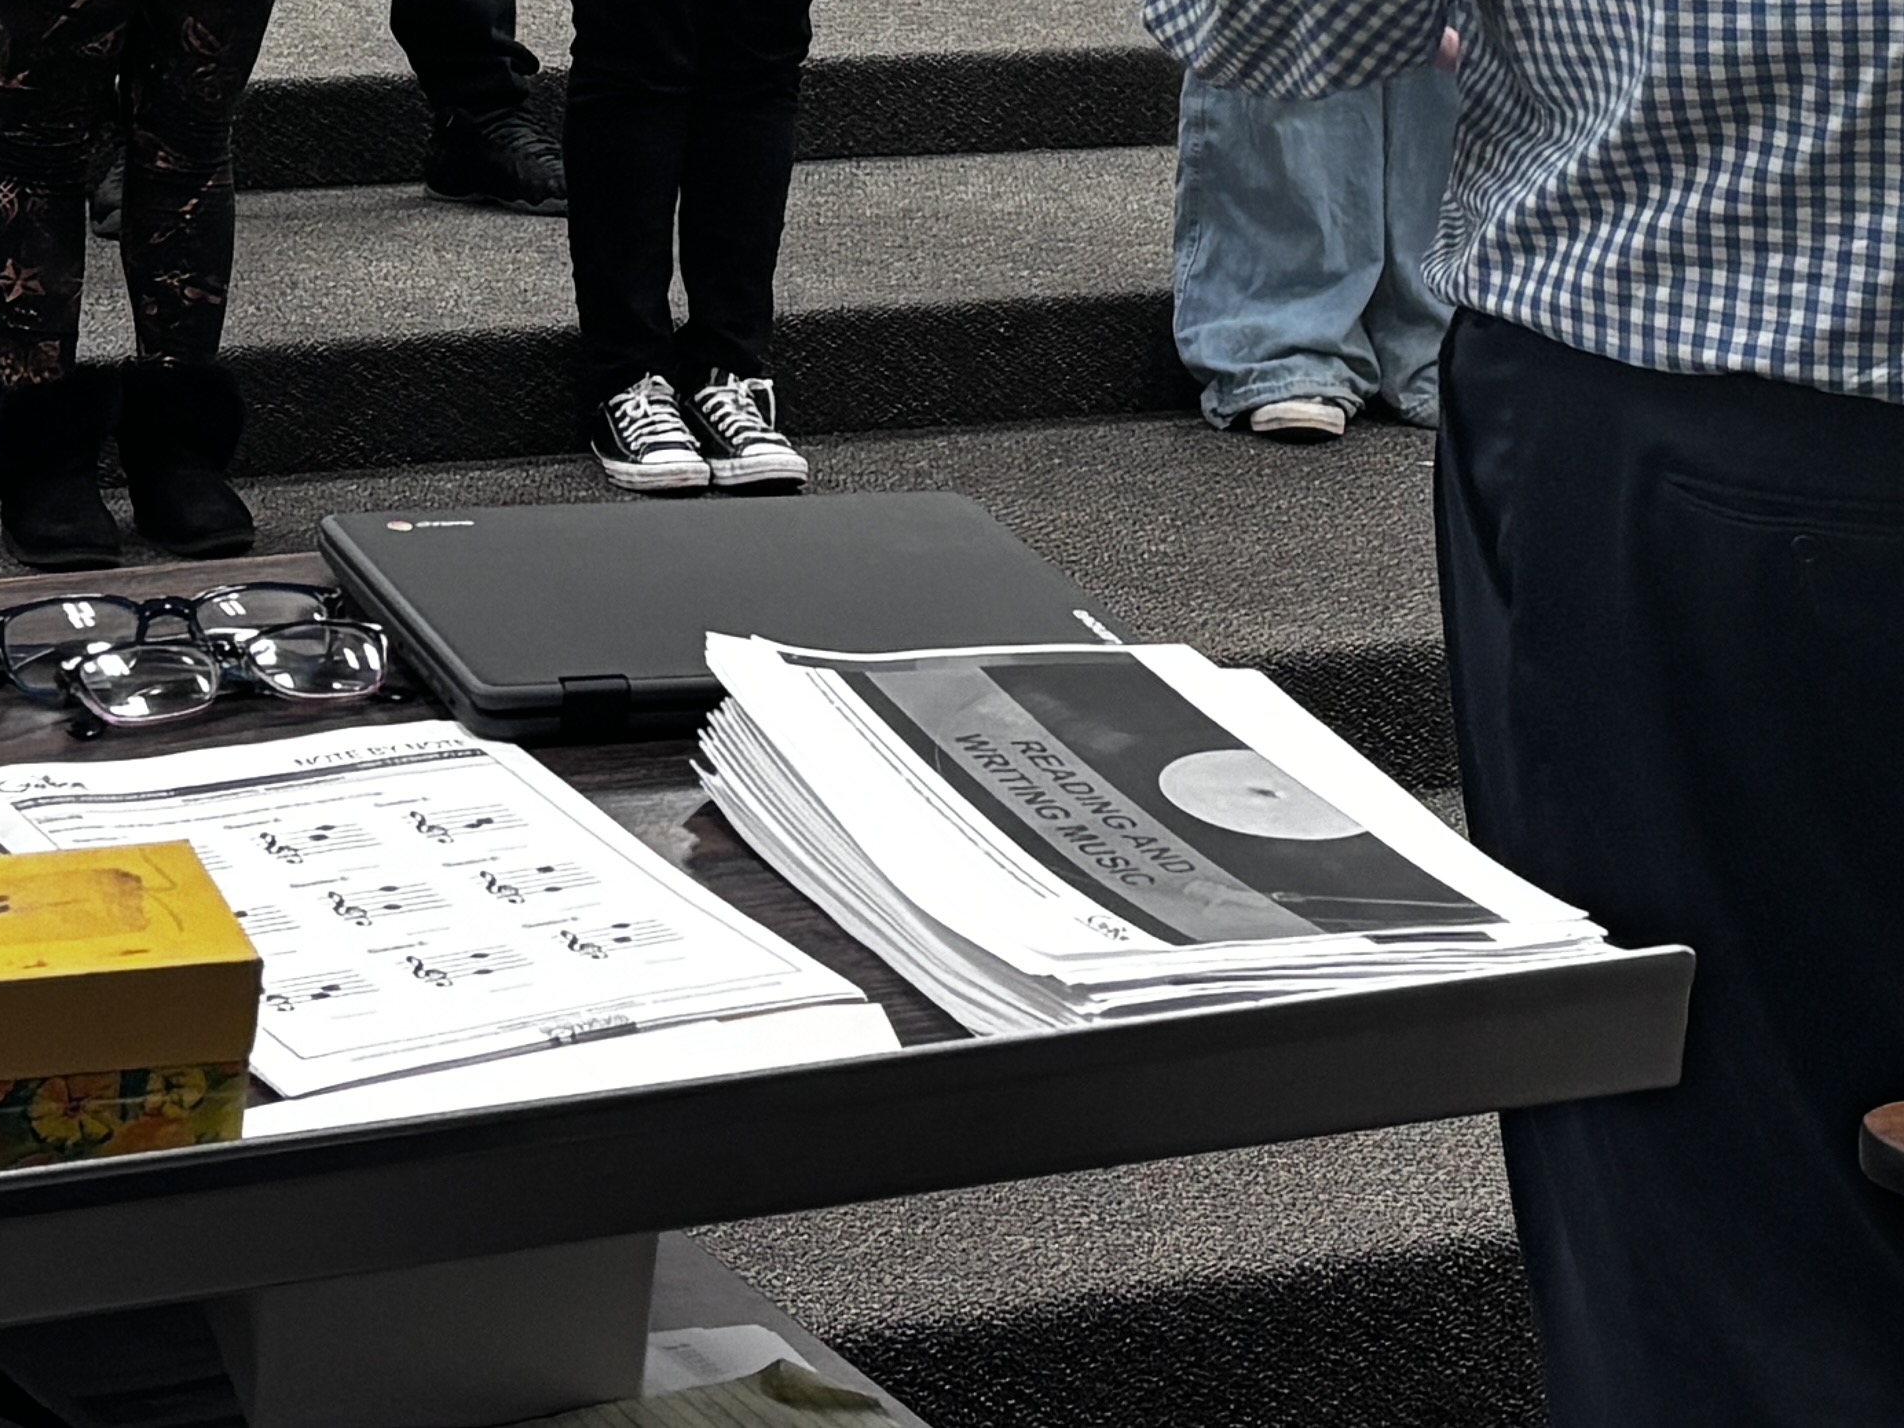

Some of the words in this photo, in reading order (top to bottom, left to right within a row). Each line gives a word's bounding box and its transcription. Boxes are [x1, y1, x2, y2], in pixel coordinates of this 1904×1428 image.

[954, 733, 1071, 821] WRITING
[1055, 824, 1156, 886] MUSIC
[1010, 739, 1137, 830] READING
[1121, 833, 1196, 875] AND
